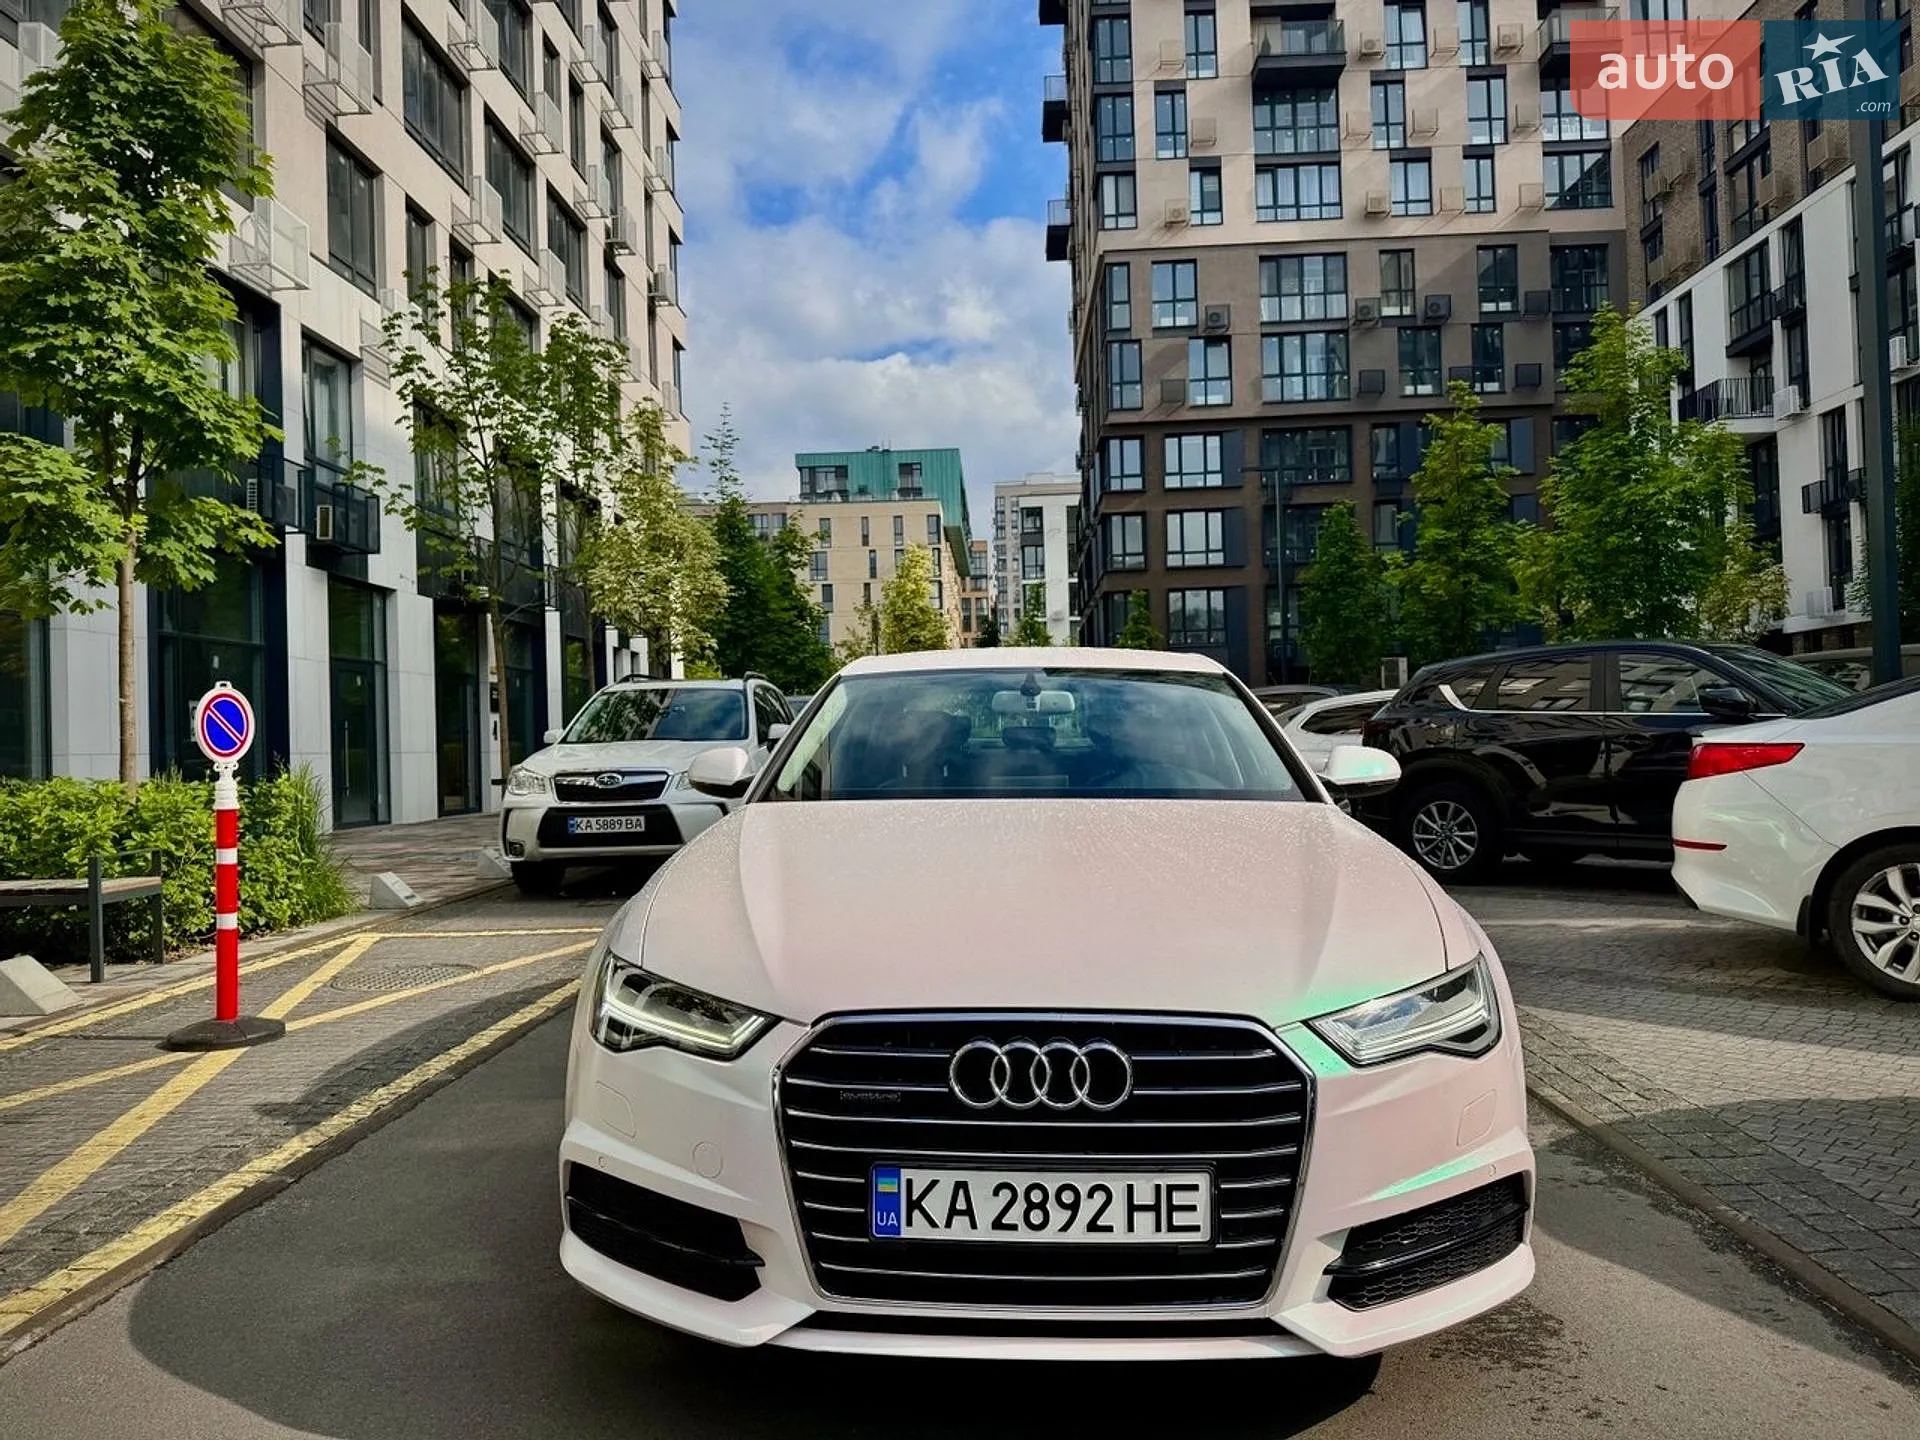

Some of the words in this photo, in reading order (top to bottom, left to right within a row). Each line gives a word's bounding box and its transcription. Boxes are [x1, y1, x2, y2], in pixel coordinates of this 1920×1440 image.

[576, 819, 593, 831] KA
[595, 818, 623, 831] 5889
[625, 817, 643, 830] BA
[905, 1177, 978, 1230] KA
[991, 1181, 1114, 1233] 2892
[1126, 1183, 1201, 1233] HE
[877, 1211, 898, 1228] UA
